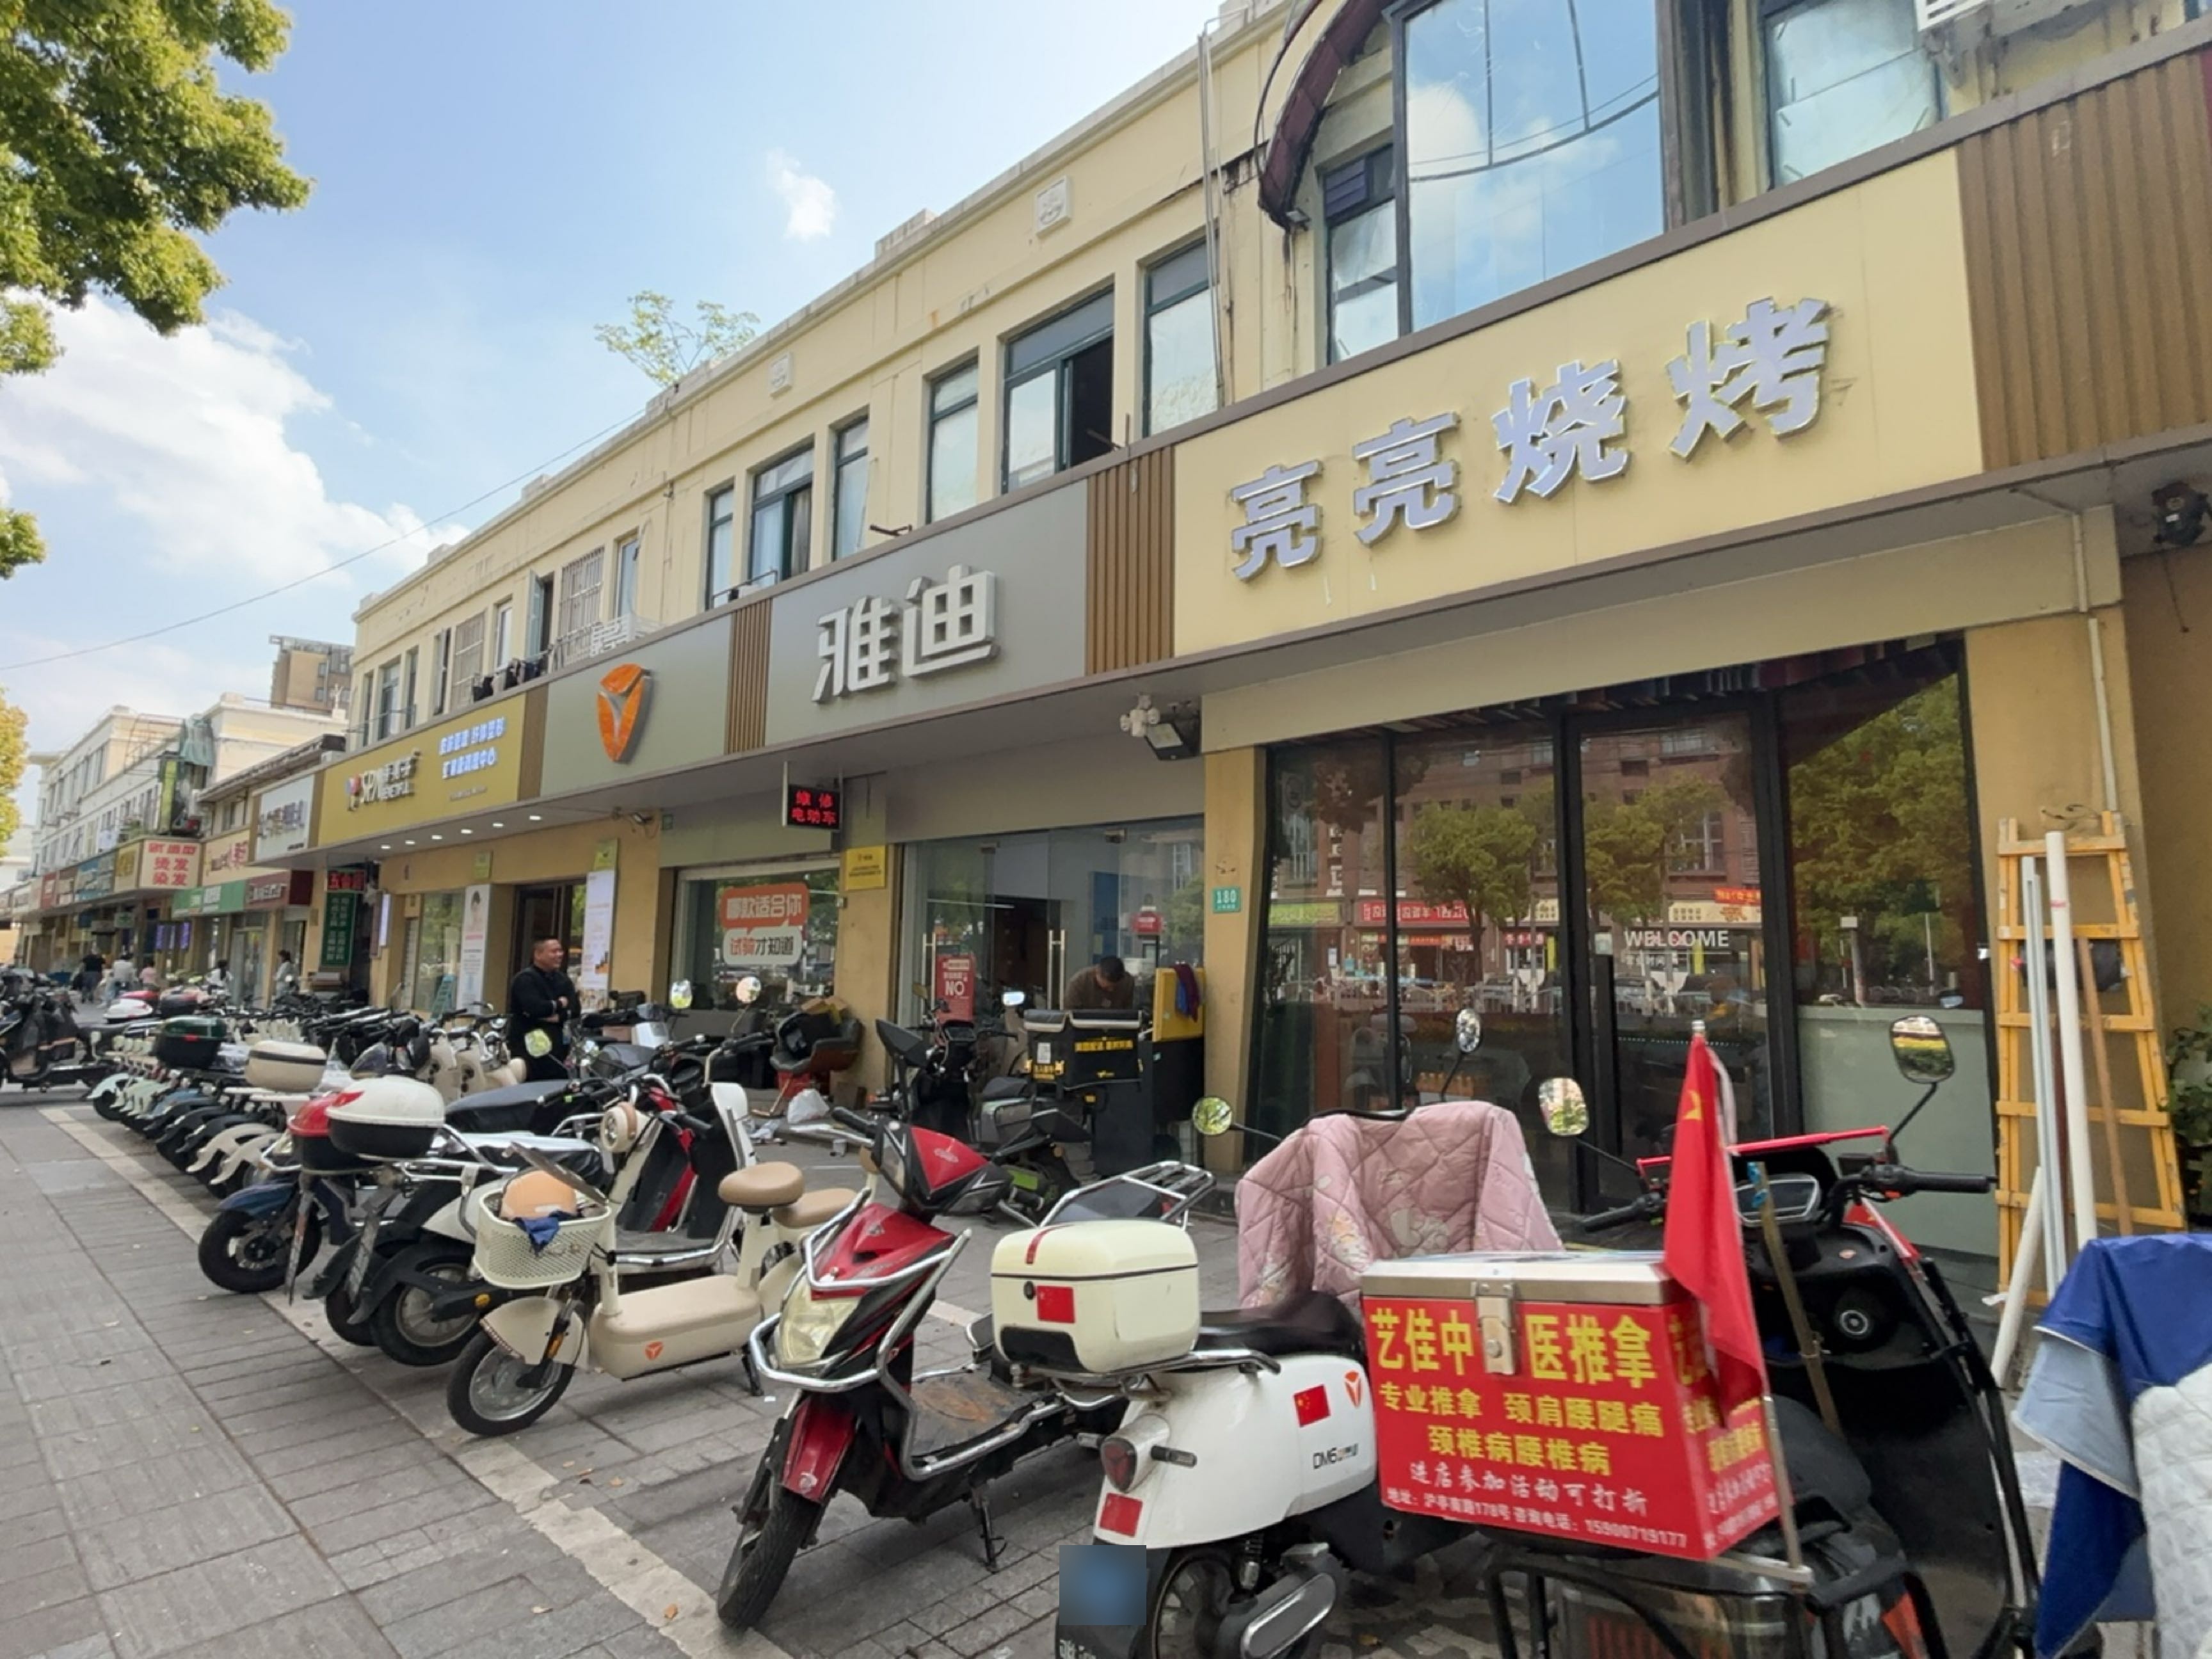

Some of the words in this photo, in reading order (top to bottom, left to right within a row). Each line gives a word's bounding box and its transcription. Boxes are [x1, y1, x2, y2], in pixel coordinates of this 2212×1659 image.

[1231, 296, 1829, 581] 亮亮烧烤
[812, 564, 998, 703] 雅迪
[791, 807, 836, 826] 电动车
[796, 790, 833, 808] 维修
[726, 894, 803, 920] 哪款适合你
[1216, 889, 1237, 904] 180
[1624, 929, 1729, 947] WELCOME
[1379, 1381, 1483, 1419] 专业推拿
[1503, 1392, 1665, 1438] 颈肩腰腿痛
[1428, 1425, 1612, 1476] 颈椎病腰椎病
[1410, 1460, 1648, 1518] 进店参加活动可打折
